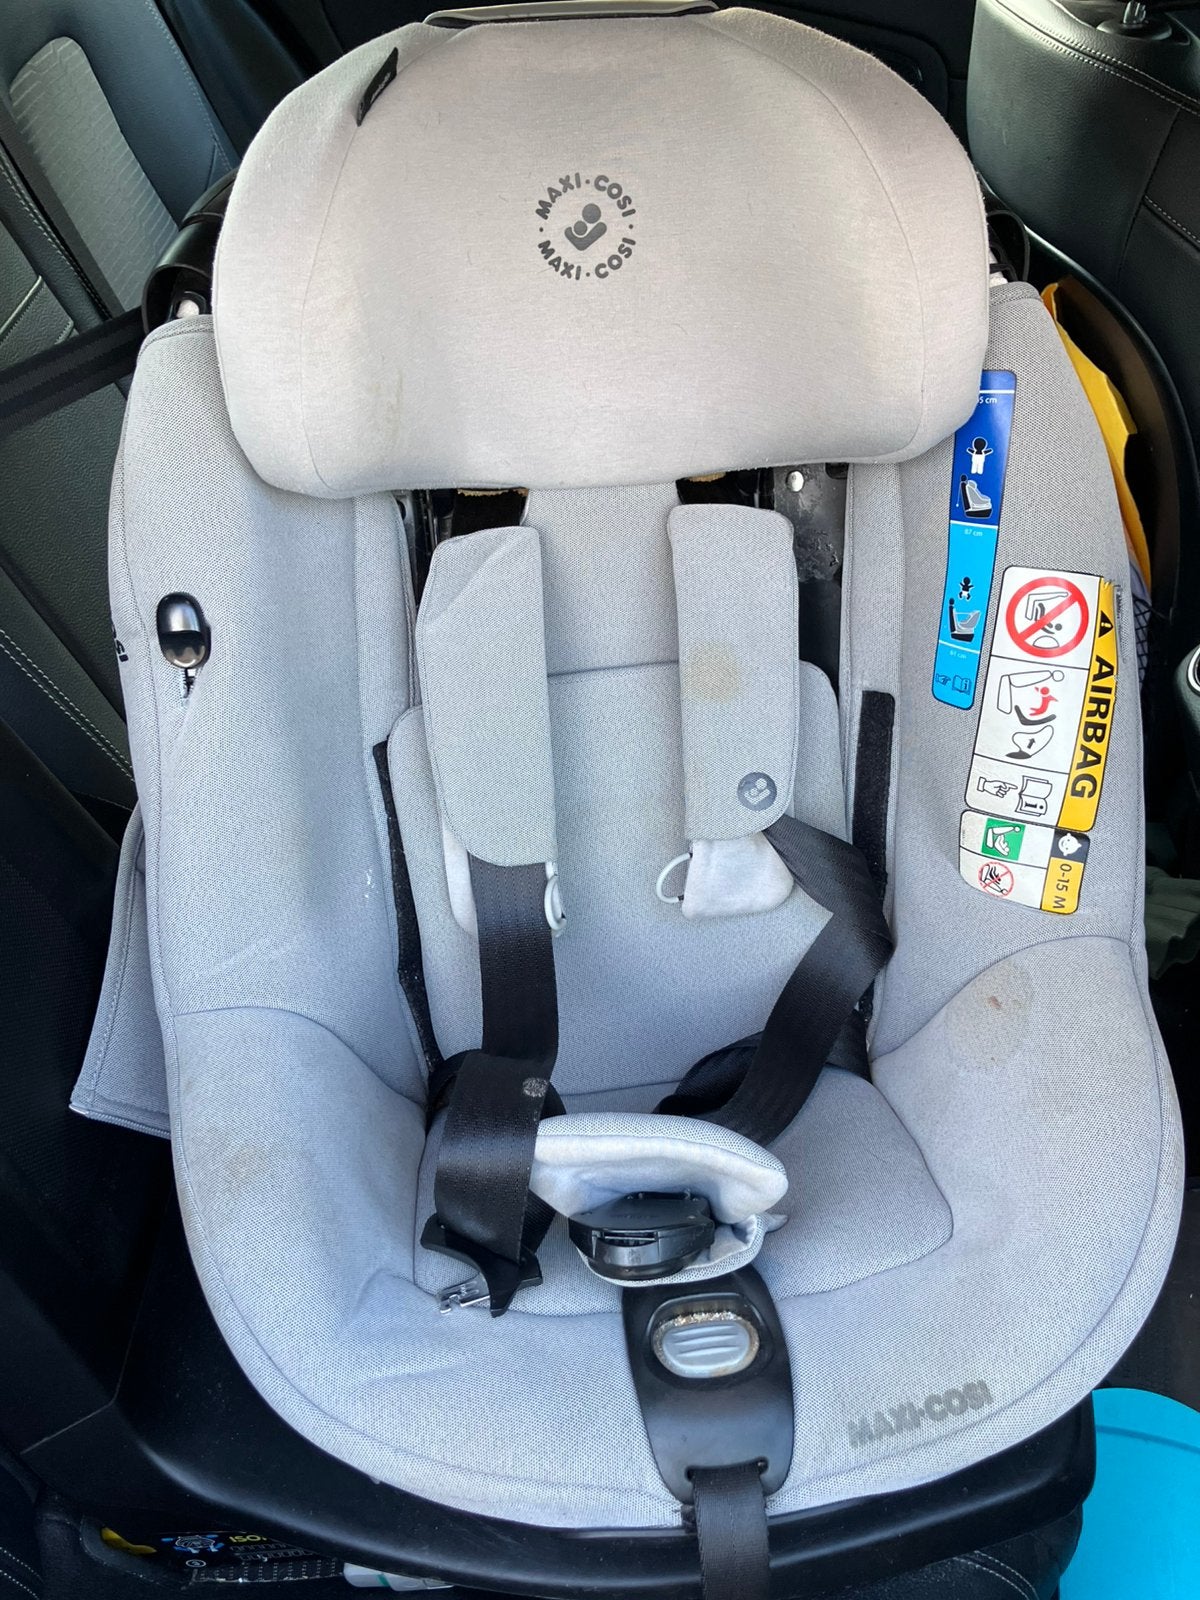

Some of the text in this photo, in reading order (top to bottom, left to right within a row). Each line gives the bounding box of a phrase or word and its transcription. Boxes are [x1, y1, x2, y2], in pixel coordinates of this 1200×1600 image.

[1070, 655, 1115, 799] AIRBAG
[1052, 863, 1072, 909] 0-15 M
